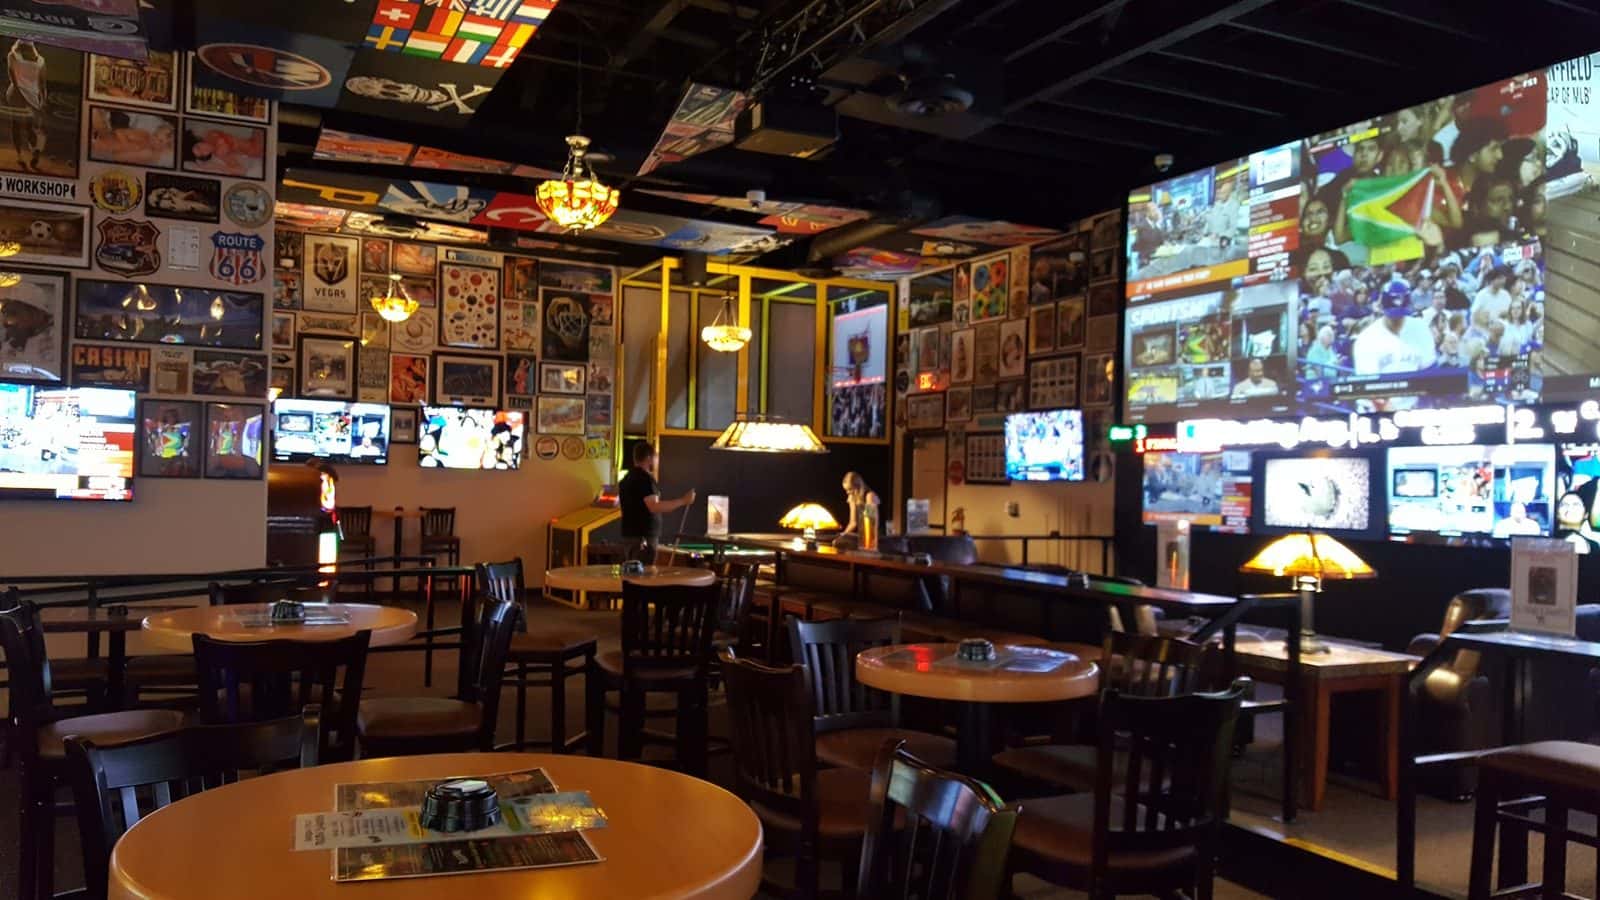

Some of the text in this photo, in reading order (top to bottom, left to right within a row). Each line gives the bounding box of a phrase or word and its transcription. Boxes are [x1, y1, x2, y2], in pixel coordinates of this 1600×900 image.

[6, 177, 69, 197] WORKSHOP
[218, 235, 257, 249] ROUTE
[218, 255, 256, 280] 66
[314, 287, 347, 299] VEGAS
[74, 347, 149, 369] CASINO
